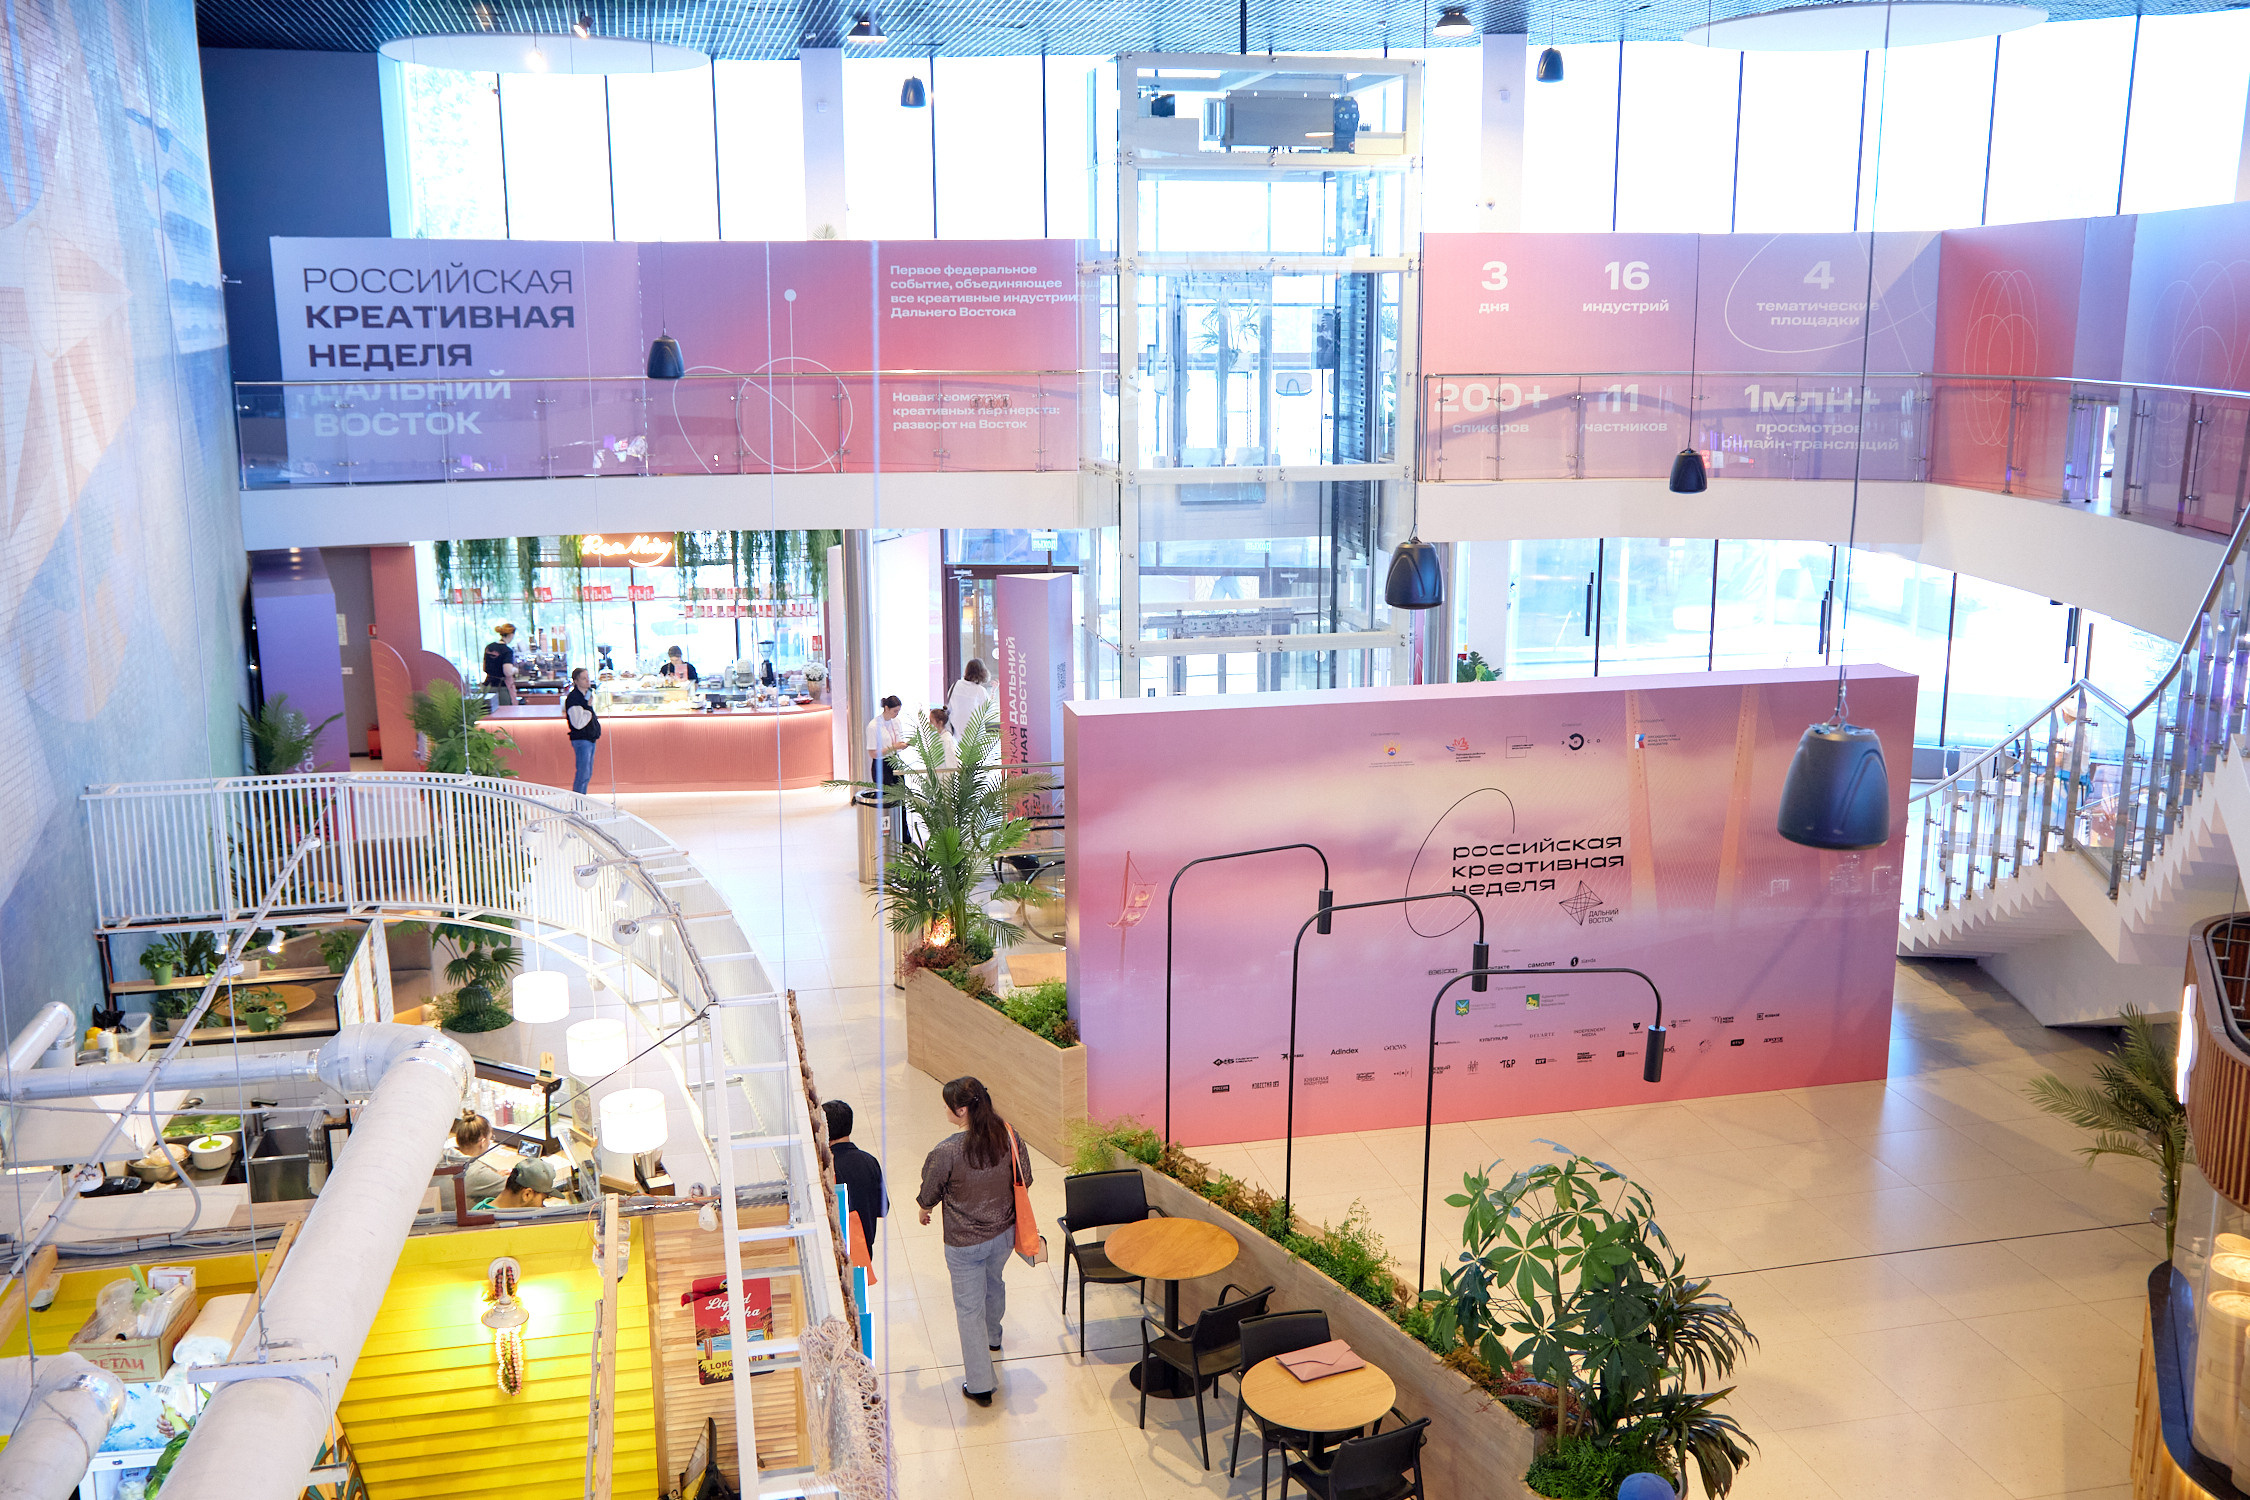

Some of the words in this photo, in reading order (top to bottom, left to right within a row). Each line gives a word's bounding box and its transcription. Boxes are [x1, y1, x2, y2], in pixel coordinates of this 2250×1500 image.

[304, 262, 573, 294] РОССИЙСКАЯ
[890, 265, 941, 277] Первое
[944, 264, 1037, 277] федеральное
[1481, 260, 1508, 291] 3
[1604, 260, 1650, 291] 16
[1803, 260, 1835, 290] 4
[890, 279, 952, 290] событие,
[955, 279, 1062, 290] объединяющее
[890, 294, 914, 303] все
[917, 294, 1000, 305] креативные
[1582, 299, 1669, 314] индустрий
[1756, 301, 1880, 312] тематические
[891, 307, 956, 319] Дальнего
[959, 306, 1016, 317] Востока
[1479, 302, 1509, 314] дня
[306, 305, 574, 329] КРЕАТИВНАЯ
[1770, 315, 1860, 327] площадки
[309, 344, 473, 372] НЕДЕЛЯ
[893, 392, 935, 402] Новая
[1434, 383, 1549, 412] 200+
[893, 407, 975, 417] креативных
[314, 411, 483, 437] ВОСТОК
[893, 420, 957, 431] разворот
[960, 421, 977, 429] на
[979, 420, 1027, 429] Восток
[1452, 423, 1530, 435] спикеров
[1006, 636, 1019, 725] ДАЛЬНИЙ
[1018, 652, 1027, 725] ВОСТОК
[1452, 836, 1622, 861] российская
[1452, 855, 1624, 879] креативная
[1452, 878, 1556, 898] неделя
[1588, 908, 1619, 918] ДАЛЬНИЙ
[1588, 916, 1614, 925] ВОСТОК
[1527, 960, 1556, 968] самолет
[705, 1293, 752, 1311] Liqd
